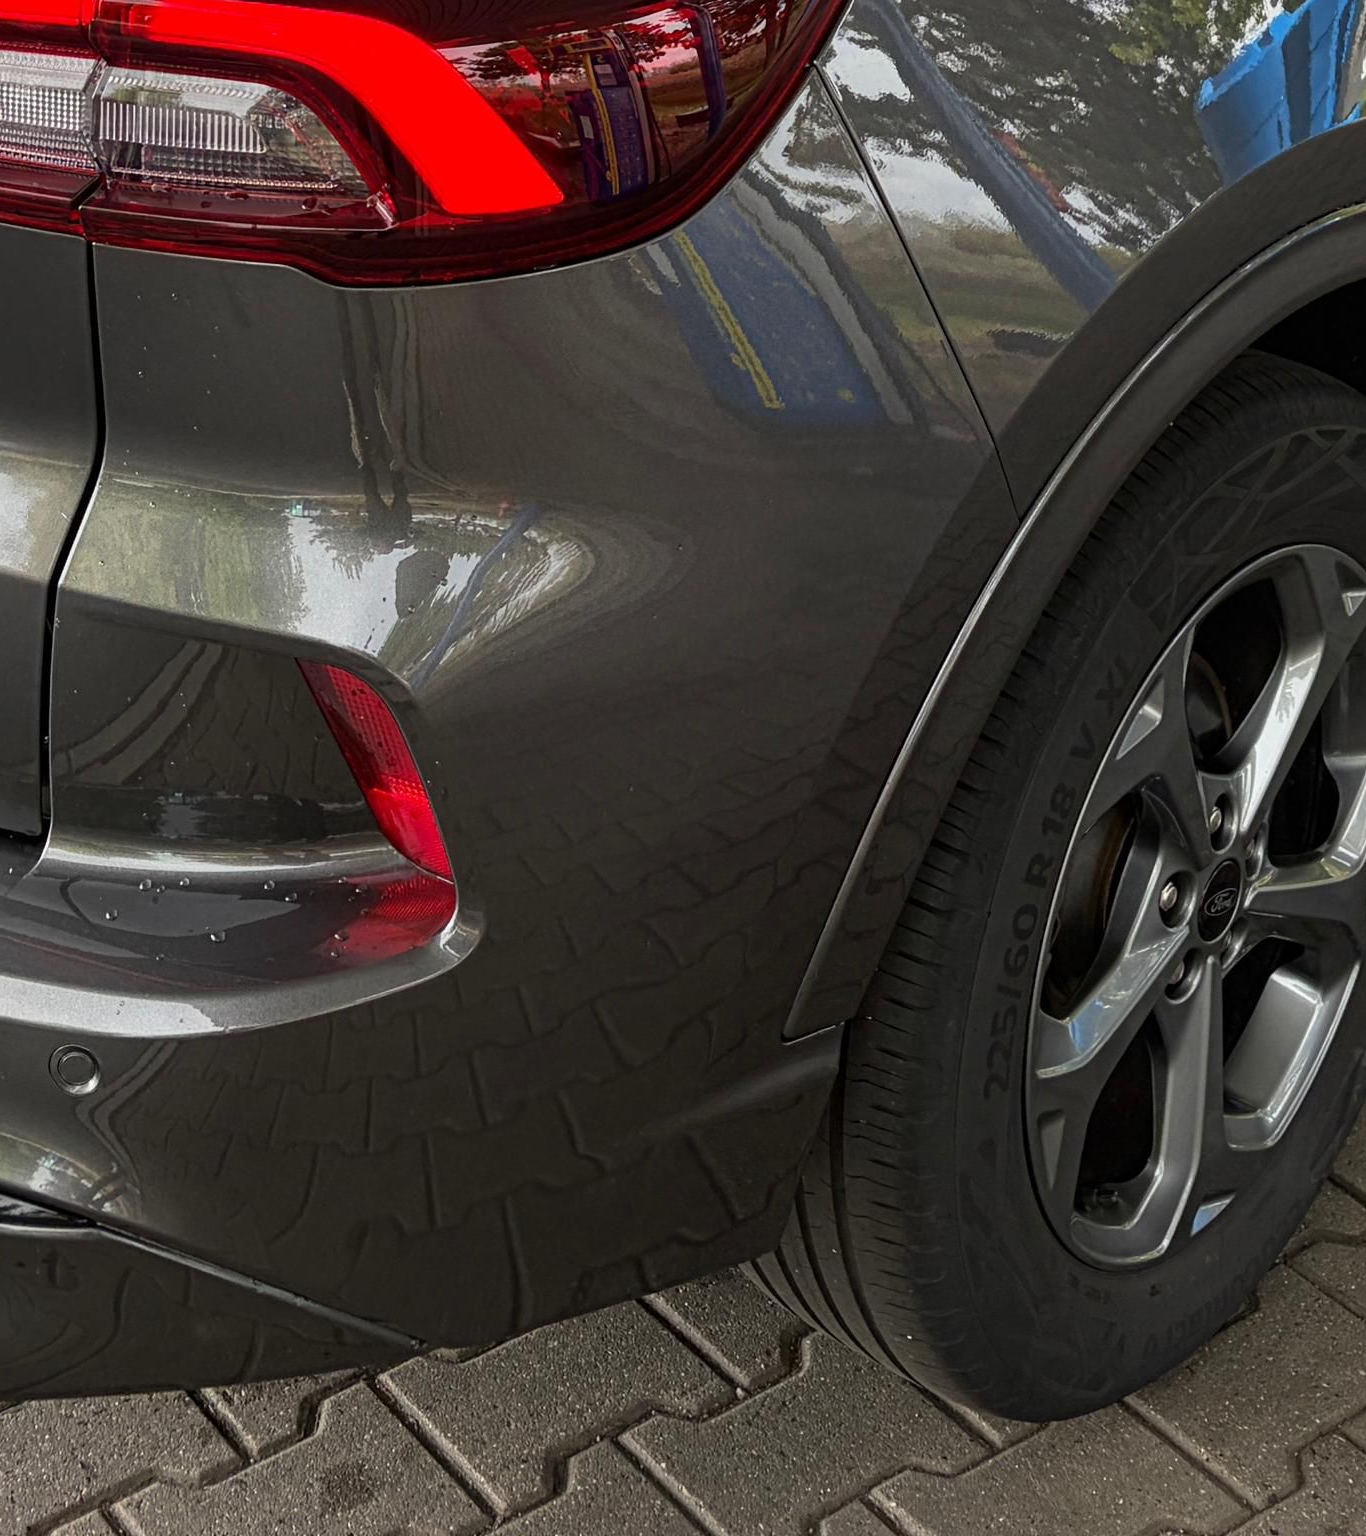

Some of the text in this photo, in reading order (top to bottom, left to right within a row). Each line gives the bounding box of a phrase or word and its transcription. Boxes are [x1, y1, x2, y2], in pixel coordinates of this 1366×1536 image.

[983, 904, 1040, 1104] 225/60
[1021, 852, 1054, 888] R
[1040, 781, 1078, 837] 18
